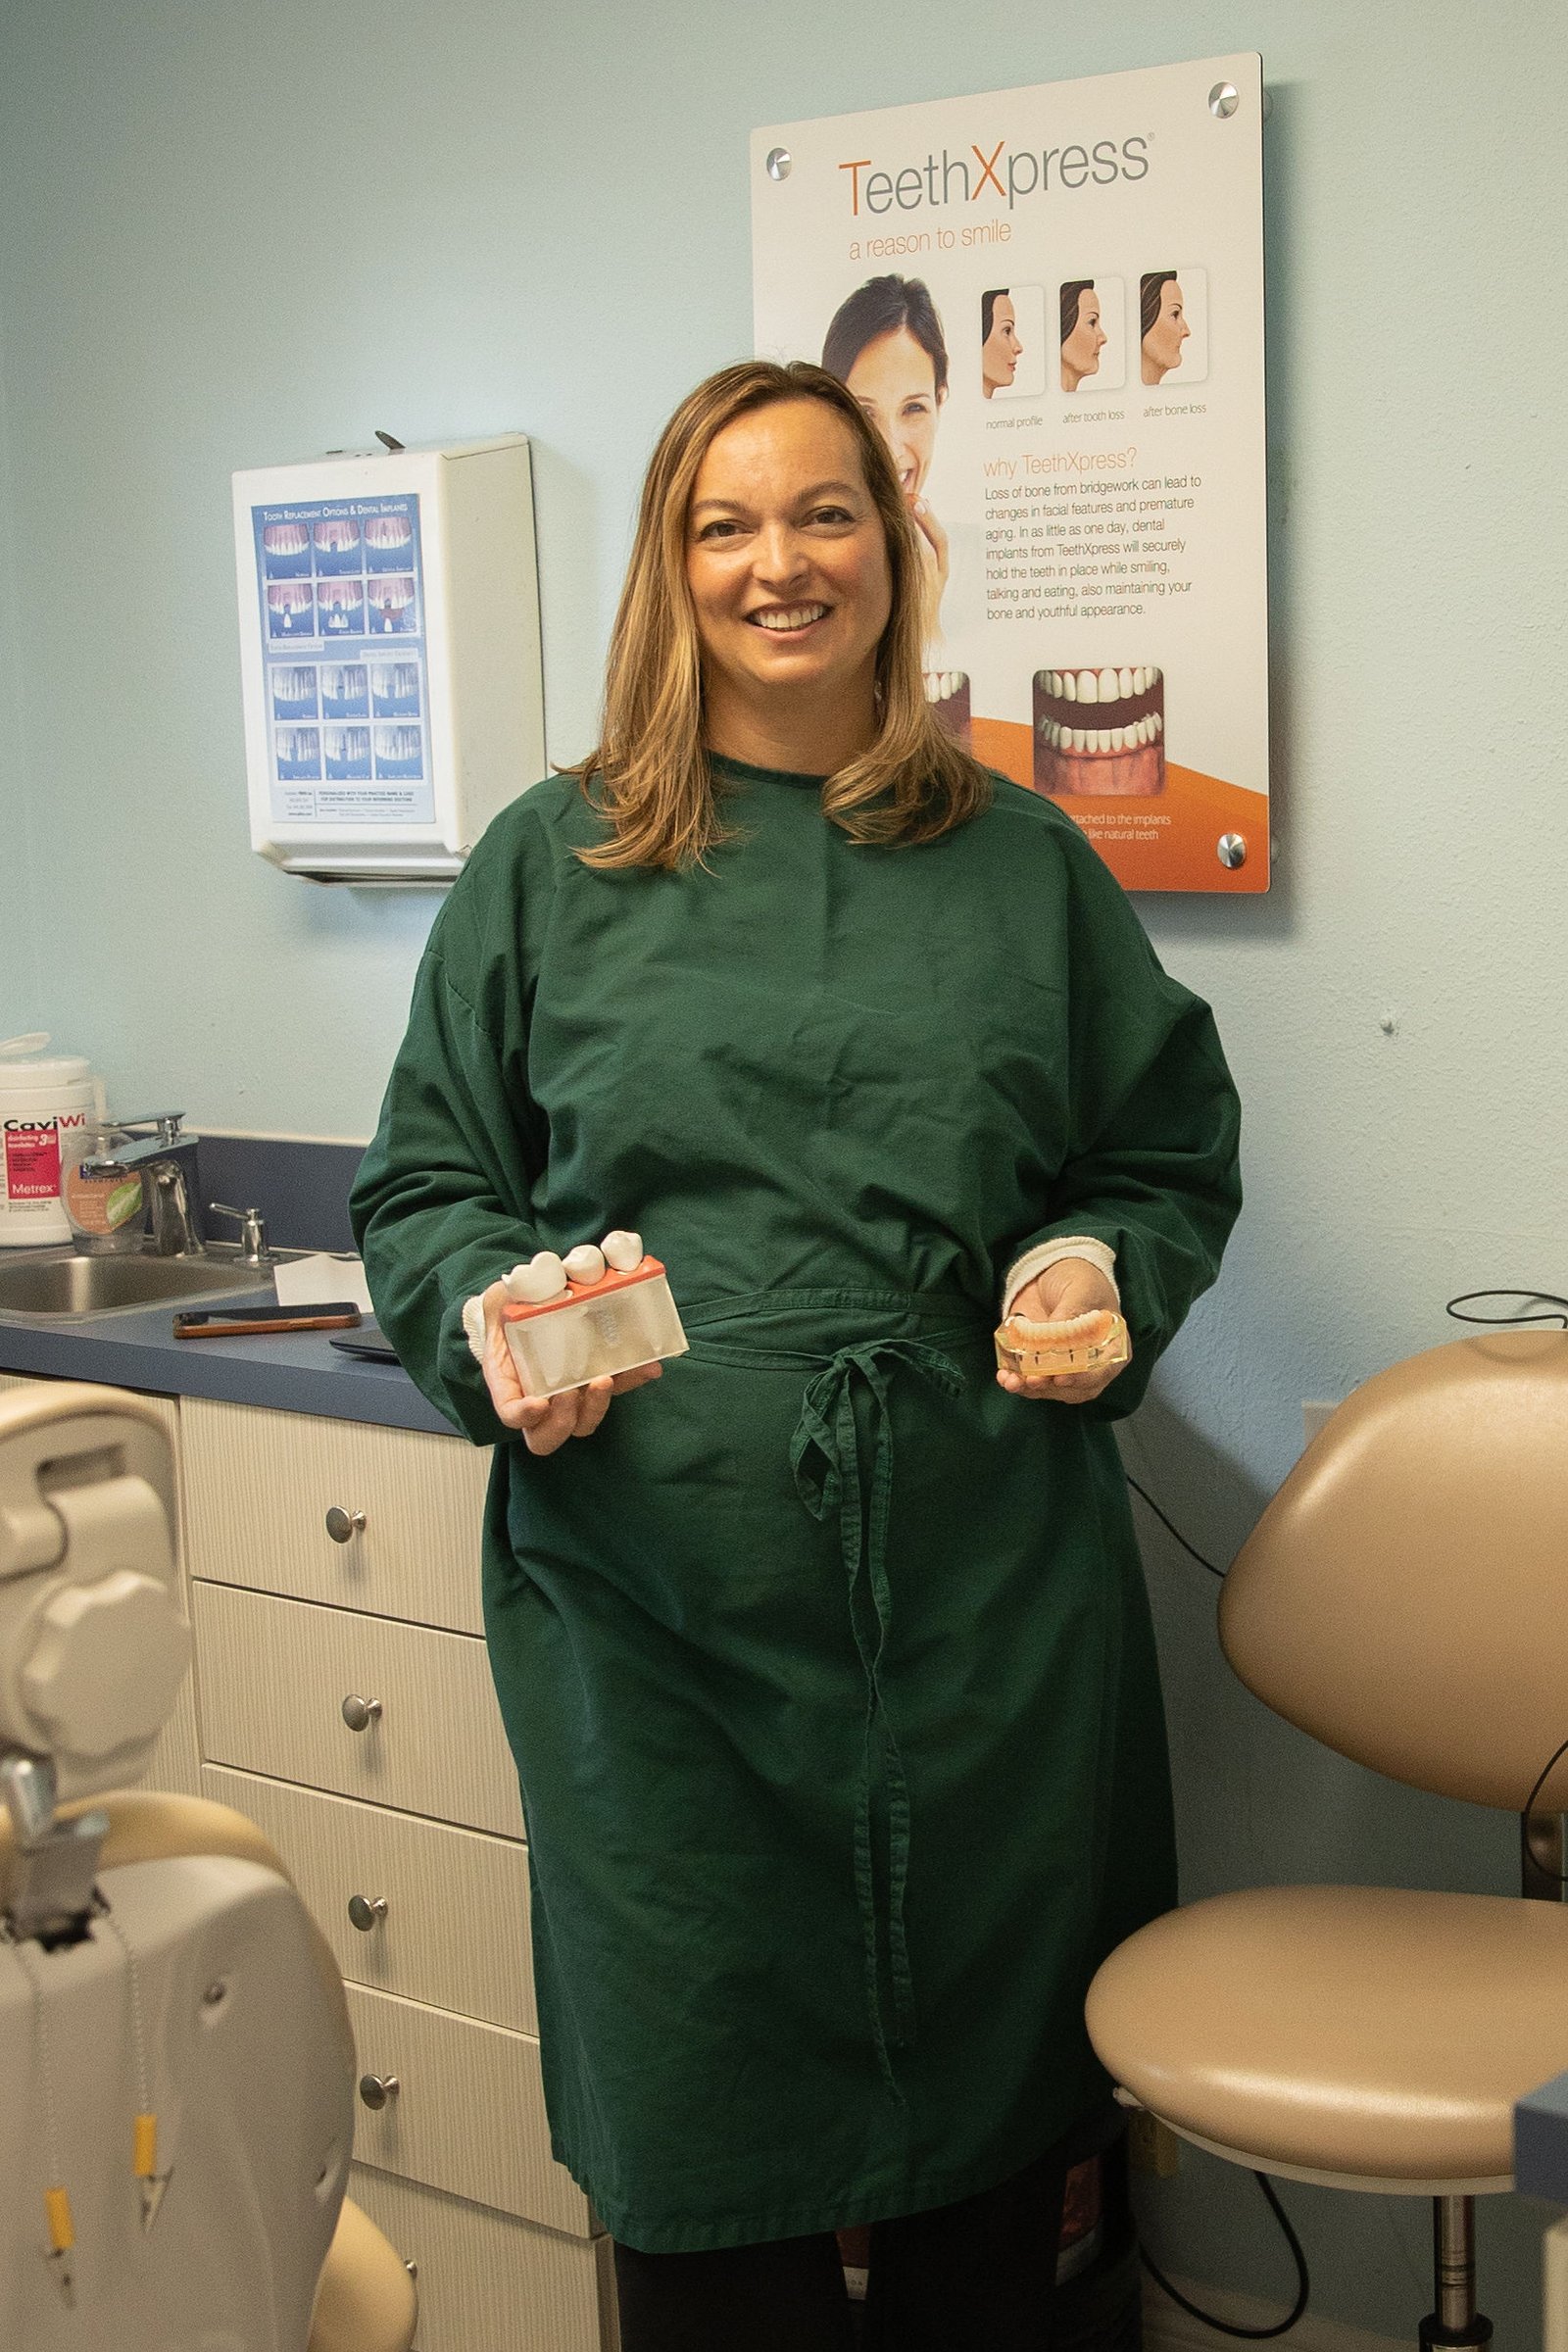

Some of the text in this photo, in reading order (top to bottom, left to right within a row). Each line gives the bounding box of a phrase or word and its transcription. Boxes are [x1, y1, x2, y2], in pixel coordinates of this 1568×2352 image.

[850, 219, 1011, 260] a reason to smile
[1062, 411, 1125, 423] after tooth loss
[1143, 404, 1206, 417] after bone loss
[986, 416, 1043, 429] normal profile
[984, 447, 1138, 479] why TeethXpress?
[985, 475, 1201, 500] Loss of bone from bridgework can lead to
[986, 497, 1194, 521] changes in facial features and premature
[986, 518, 1165, 542] aging. In as little as one day, dental
[986, 539, 1186, 562] implants from TeethXpress will securely
[986, 561, 1170, 580] hold the teeth in place while smiling,
[1022, 586, 1041, 599] and
[1044, 585, 1078, 600] eating,
[1081, 583, 1102, 595] also
[1105, 582, 1165, 596] maintaining
[1168, 581, 1192, 594] your
[987, 603, 1146, 620] bone and youthful appearance.
[1106, 814, 1116, 824] to
[1117, 813, 1132, 824] the
[1133, 813, 1171, 827] implants
[1088, 828, 1159, 840] like natural teeth
